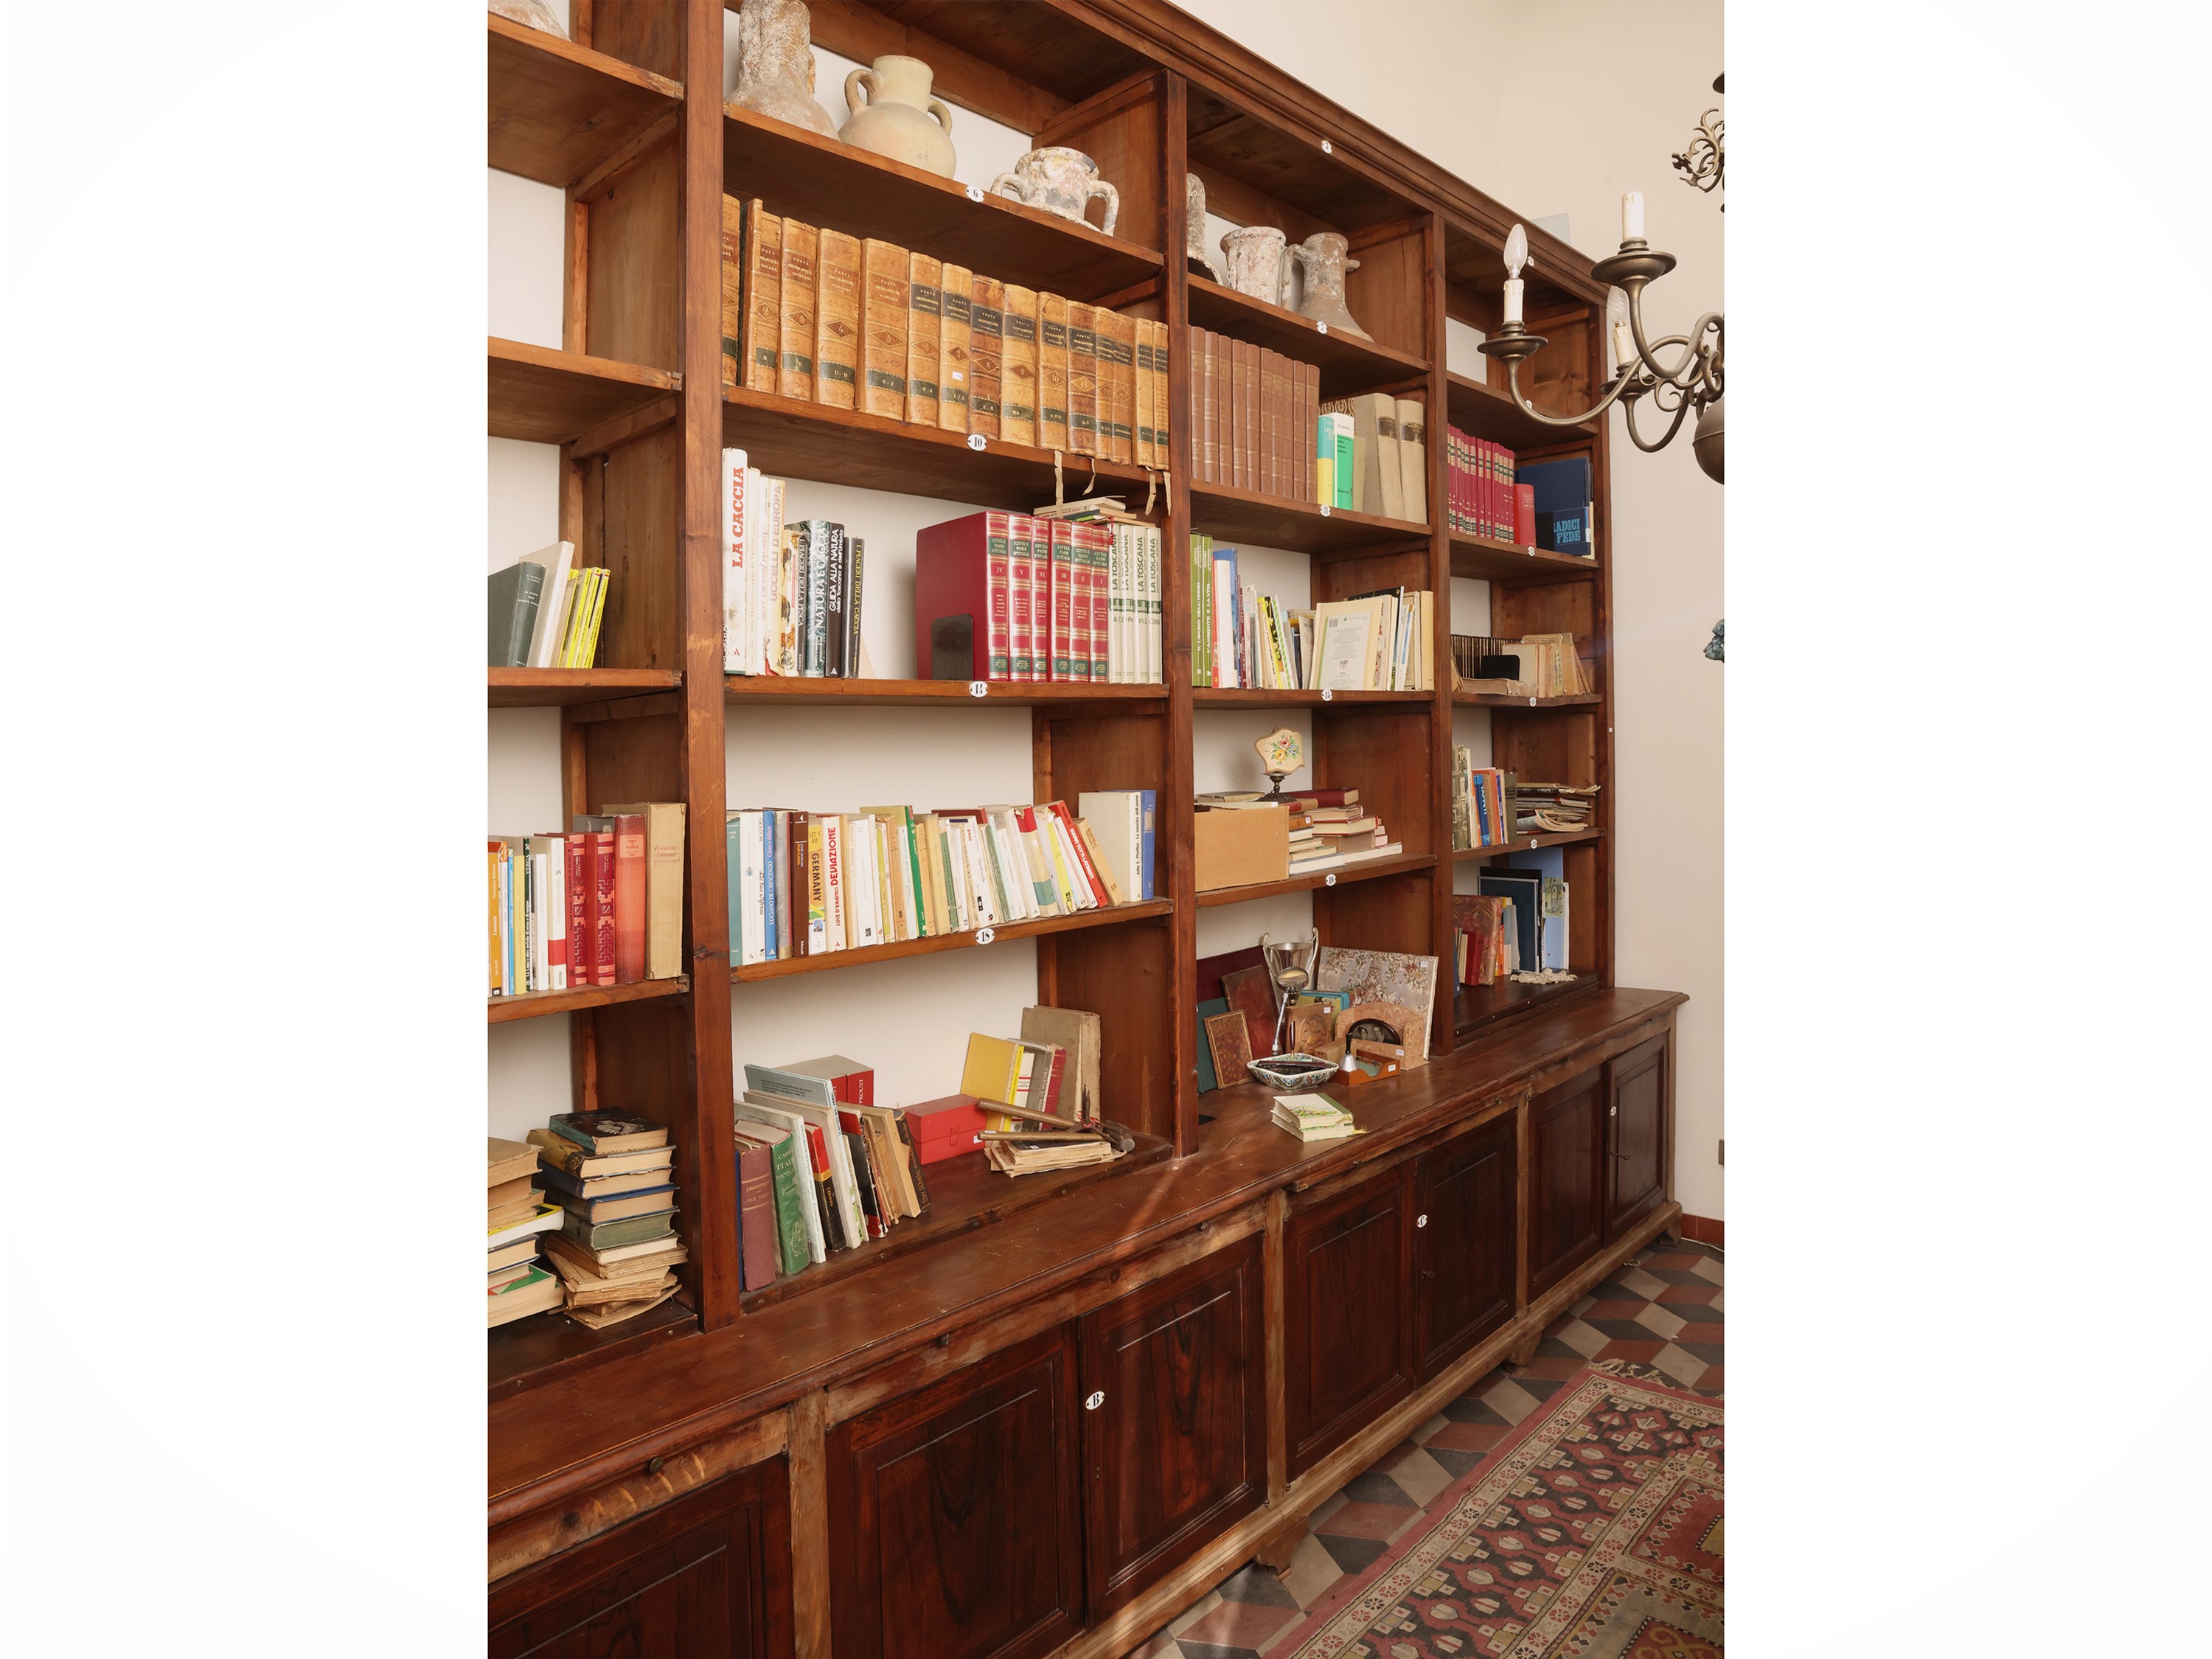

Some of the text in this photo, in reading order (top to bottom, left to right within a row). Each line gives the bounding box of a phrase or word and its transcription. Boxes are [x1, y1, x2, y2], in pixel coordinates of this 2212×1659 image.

[973, 189, 978, 198] 6
[762, 307, 768, 315] 2
[886, 334, 892, 343] 5
[925, 344, 930, 352] 6
[986, 361, 991, 369] 8
[1051, 374, 1060, 383] 10
[974, 437, 982, 447] 10
[732, 467, 744, 568] LA CACCIA
[1557, 530, 1581, 543] FEDE
[771, 485, 782, 602] UCCELLI D'EUROPA
[1112, 579, 1118, 591] LA
[1121, 580, 1129, 591] LA
[1138, 581, 1144, 592] LA
[1150, 582, 1155, 593] LA
[815, 577, 826, 628] NATURA
[830, 584, 838, 611] GUIDA
[1206, 598, 1210, 606] LA
[975, 684, 983, 694] 14
[1061, 806, 1071, 825] MARCHI
[1069, 828, 1079, 843] SIAMO
[1076, 844, 1085, 857] TUTTI
[1081, 858, 1094, 879] LATINISTI
[827, 827, 838, 886] DEVIAZIONE
[811, 852, 821, 902] GERMANY
[982, 932, 990, 942] 18
[1039, 1067, 1049, 1100] cucina in
[1419, 1215, 1425, 1225] C
[1093, 1394, 1099, 1406] B
